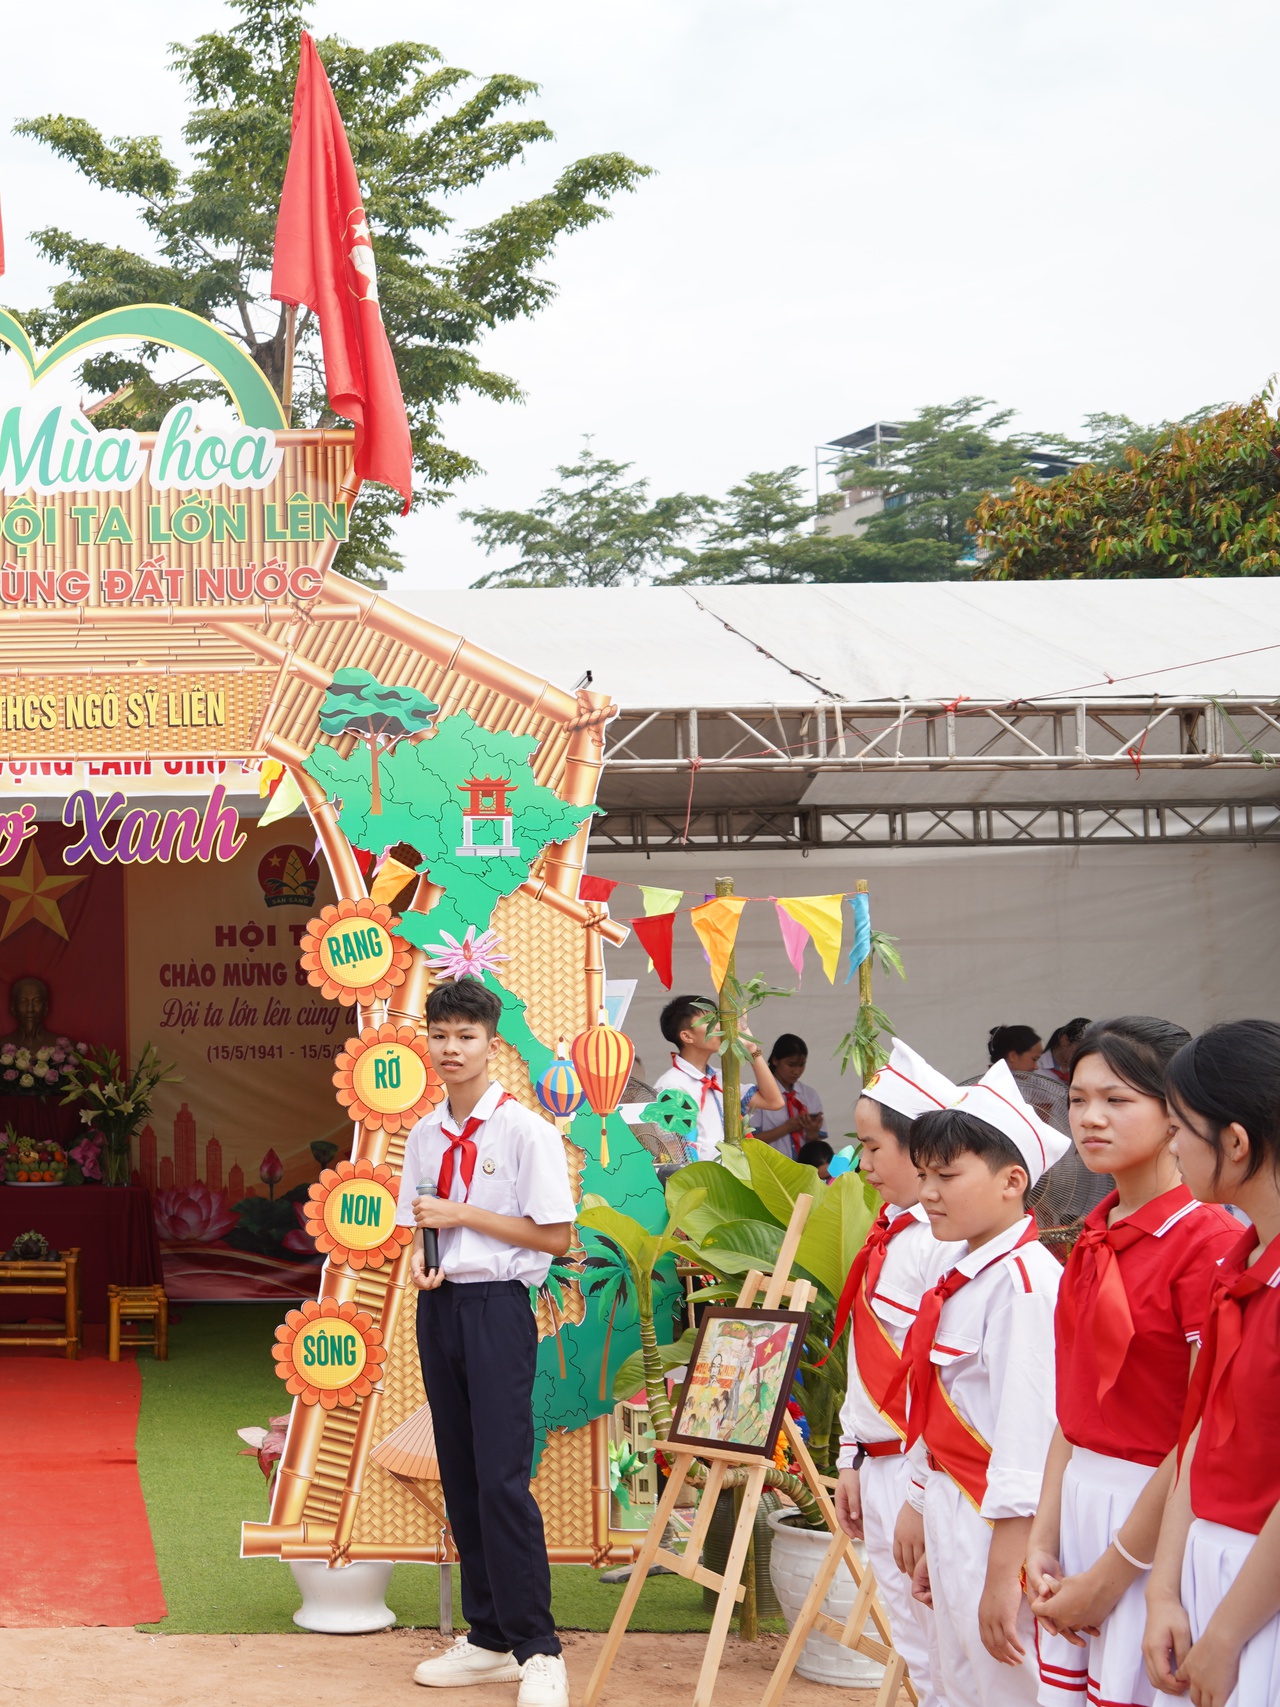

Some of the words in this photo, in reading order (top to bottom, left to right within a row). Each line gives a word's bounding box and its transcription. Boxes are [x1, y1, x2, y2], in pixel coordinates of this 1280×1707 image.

[158, 406, 274, 481] hoa
[72, 504, 134, 545] TA
[149, 492, 248, 543] LỚN
[263, 491, 348, 542] LÊN
[103, 555, 186, 603] ĐẤT
[198, 557, 324, 601] NƯỚC
[65, 685, 119, 730] NGÔ
[127, 685, 160, 728] SỸ
[168, 684, 225, 728] LIÊN
[62, 784, 248, 866] Xanh
[215, 920, 276, 953] HỘI
[327, 927, 383, 968] RẠNG
[159, 957, 216, 987] CHÀO
[223, 957, 288, 987] MỪNG
[159, 997, 200, 1035] Đội
[204, 1001, 224, 1026] ta
[228, 997, 258, 1026] lớn
[264, 996, 292, 1026] lên
[297, 999, 342, 1035] cùng
[207, 1044, 283, 1063] (15/5/1941
[374, 1050, 401, 1089] RỠ
[340, 1193, 382, 1227] NON
[303, 1330, 357, 1367] SÔNG
